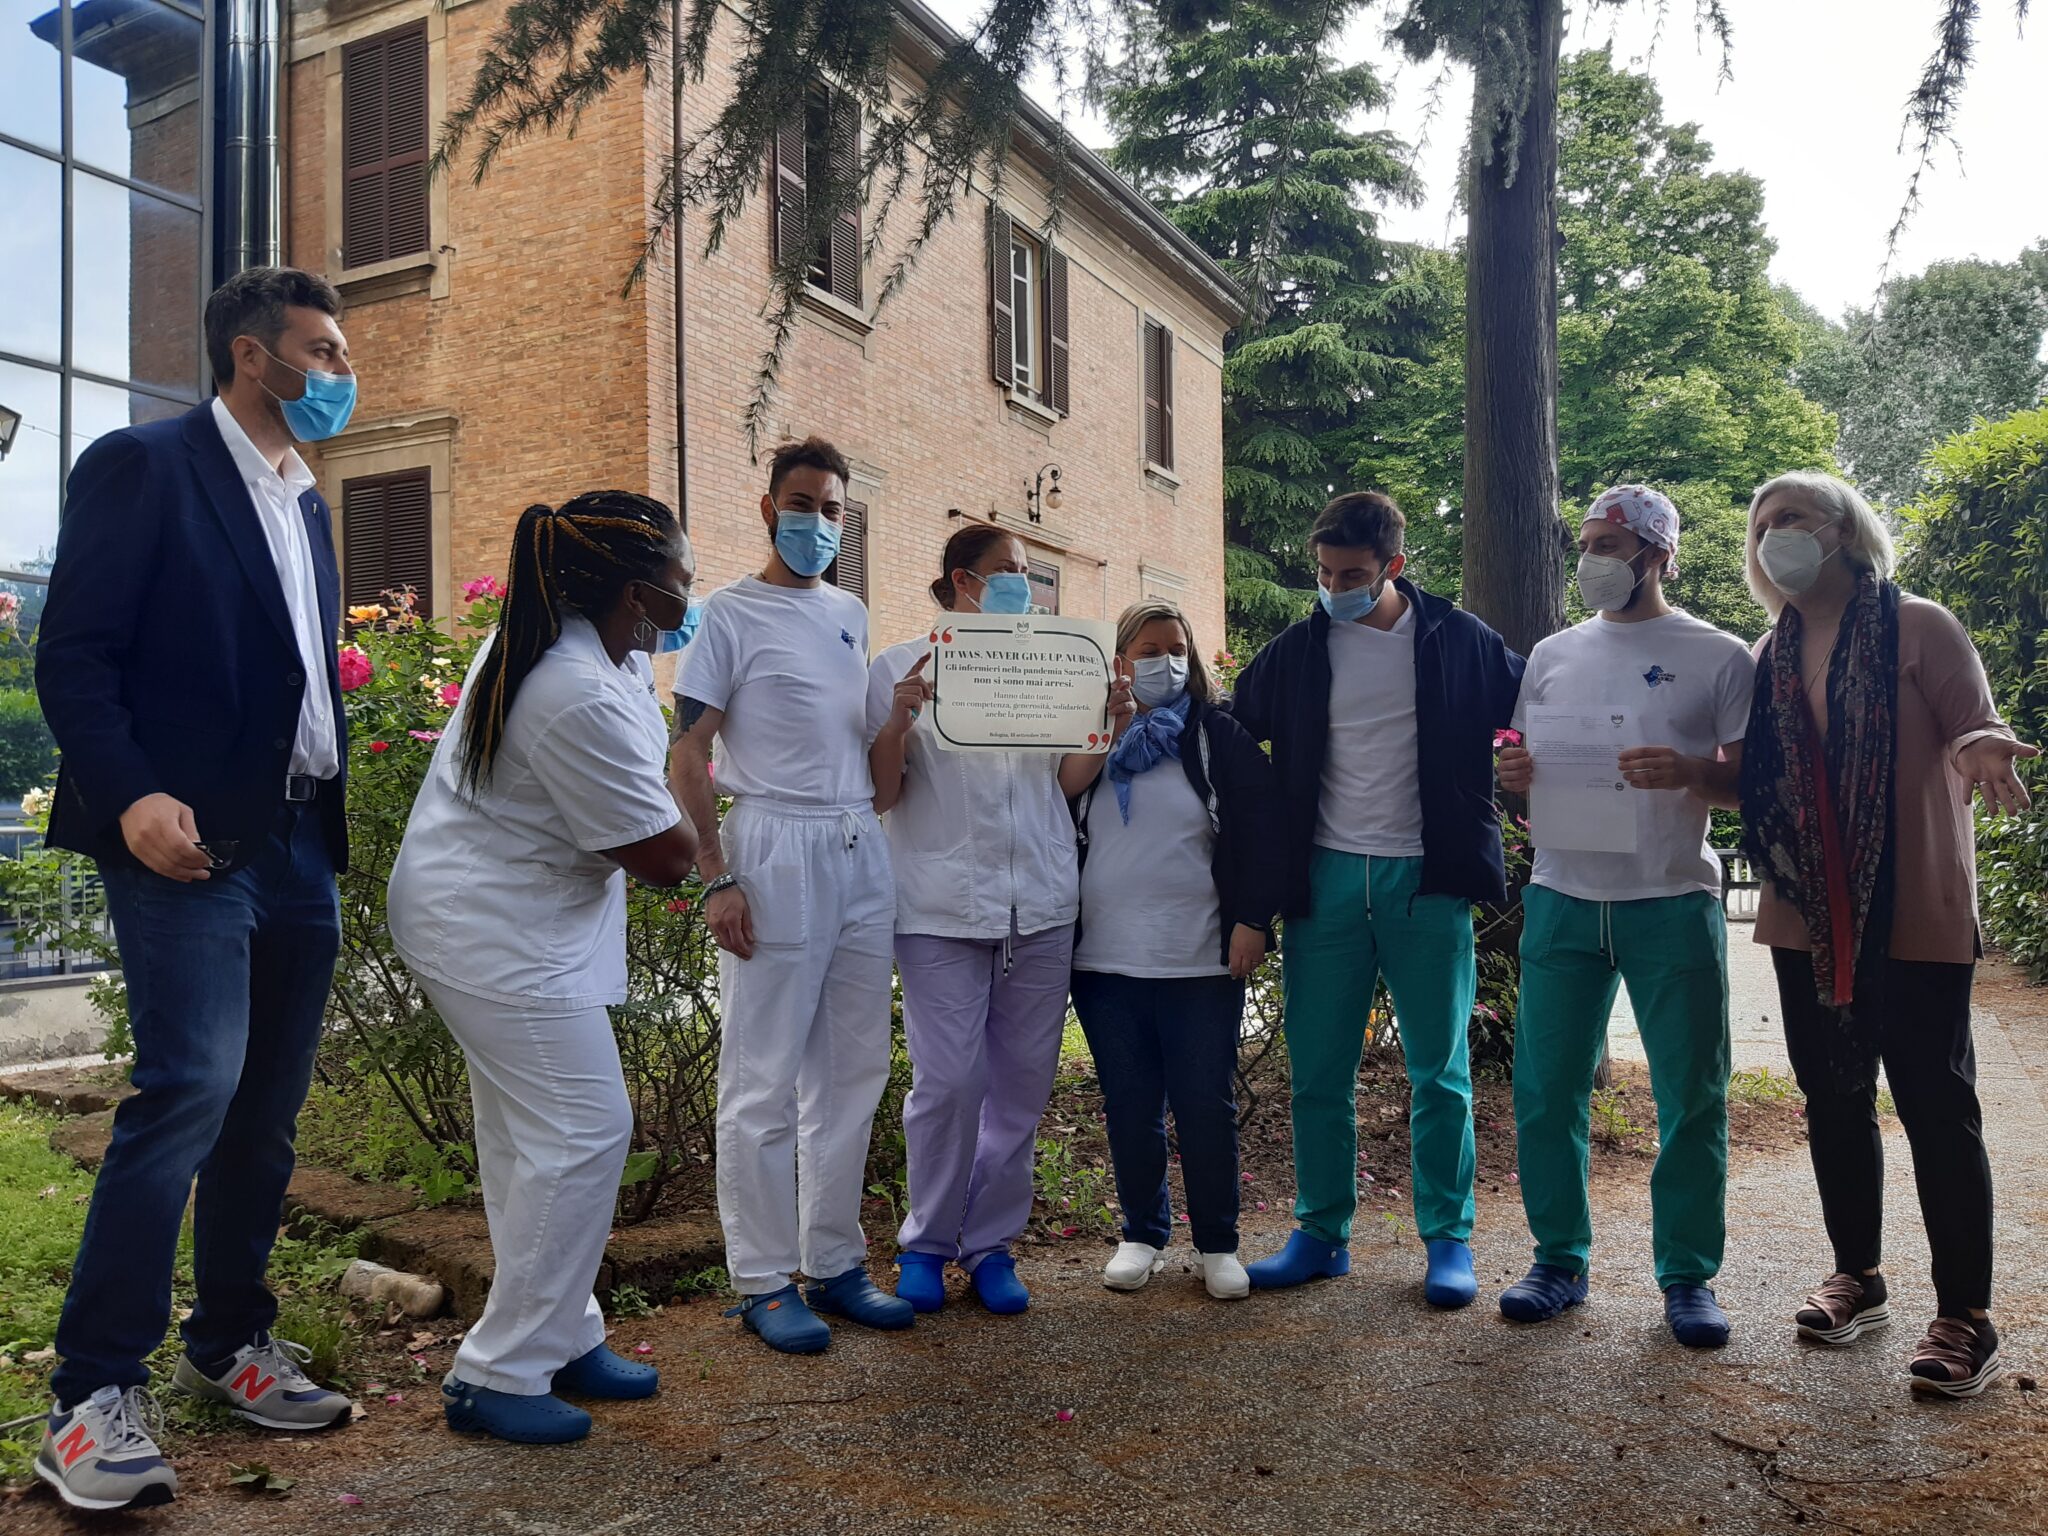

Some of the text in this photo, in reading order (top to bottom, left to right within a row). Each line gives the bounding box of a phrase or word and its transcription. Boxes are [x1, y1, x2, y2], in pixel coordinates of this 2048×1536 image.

[945, 650, 956, 659] IT
[986, 650, 1019, 660] NEVER
[1022, 652, 1047, 661] GIVE
[959, 664, 1000, 673] infermieri
[1002, 665, 1022, 673] nella
[1023, 667, 1062, 676] pandemia
[993, 676, 1001, 685] si
[1026, 678, 1043, 686] mai
[1044, 679, 1074, 688] arresi.
[994, 691, 1018, 699] Hanno
[1019, 692, 1035, 700] dato
[985, 710, 1007, 718] anche
[1015, 712, 1042, 720] propria
[230, 1363, 276, 1402] N
[56, 1423, 96, 1468] N
